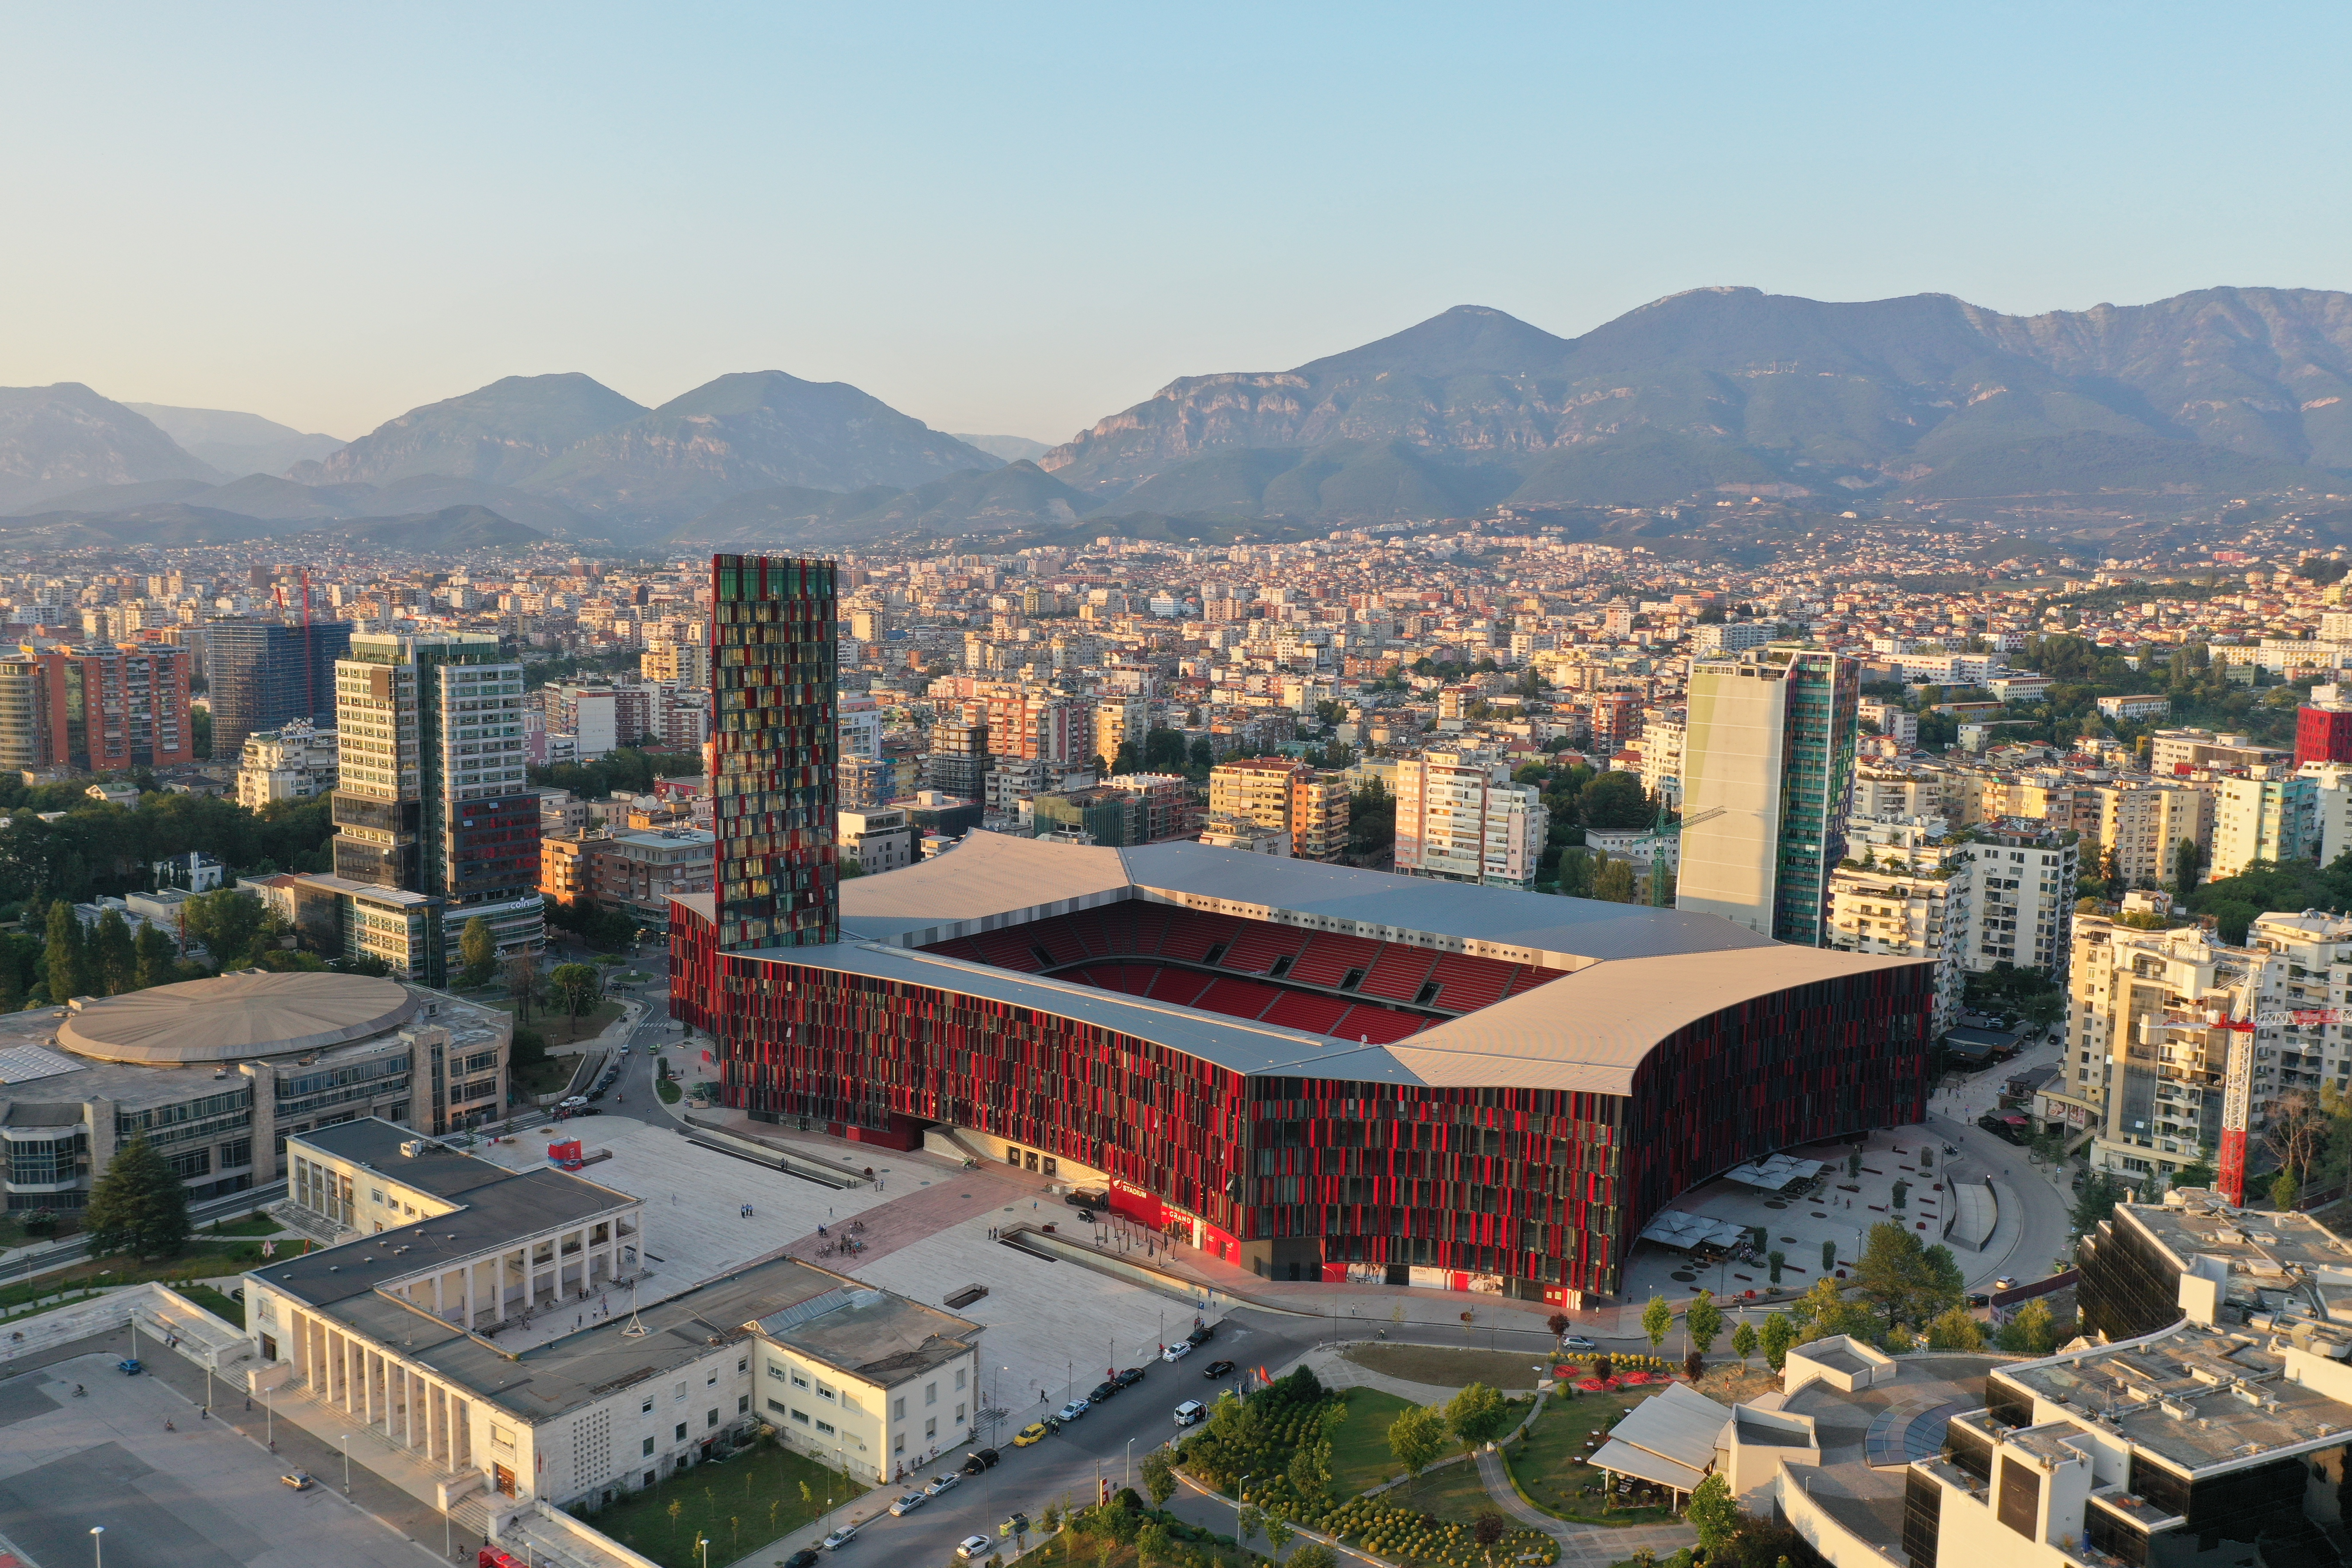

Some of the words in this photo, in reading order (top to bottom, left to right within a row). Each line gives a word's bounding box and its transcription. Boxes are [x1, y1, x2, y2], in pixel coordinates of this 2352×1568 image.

[510, 897, 530, 909] coin
[492, 946, 506, 958] oin
[1123, 1185, 1147, 1199] STADIUM
[1169, 1211, 1191, 1224] GRAND
